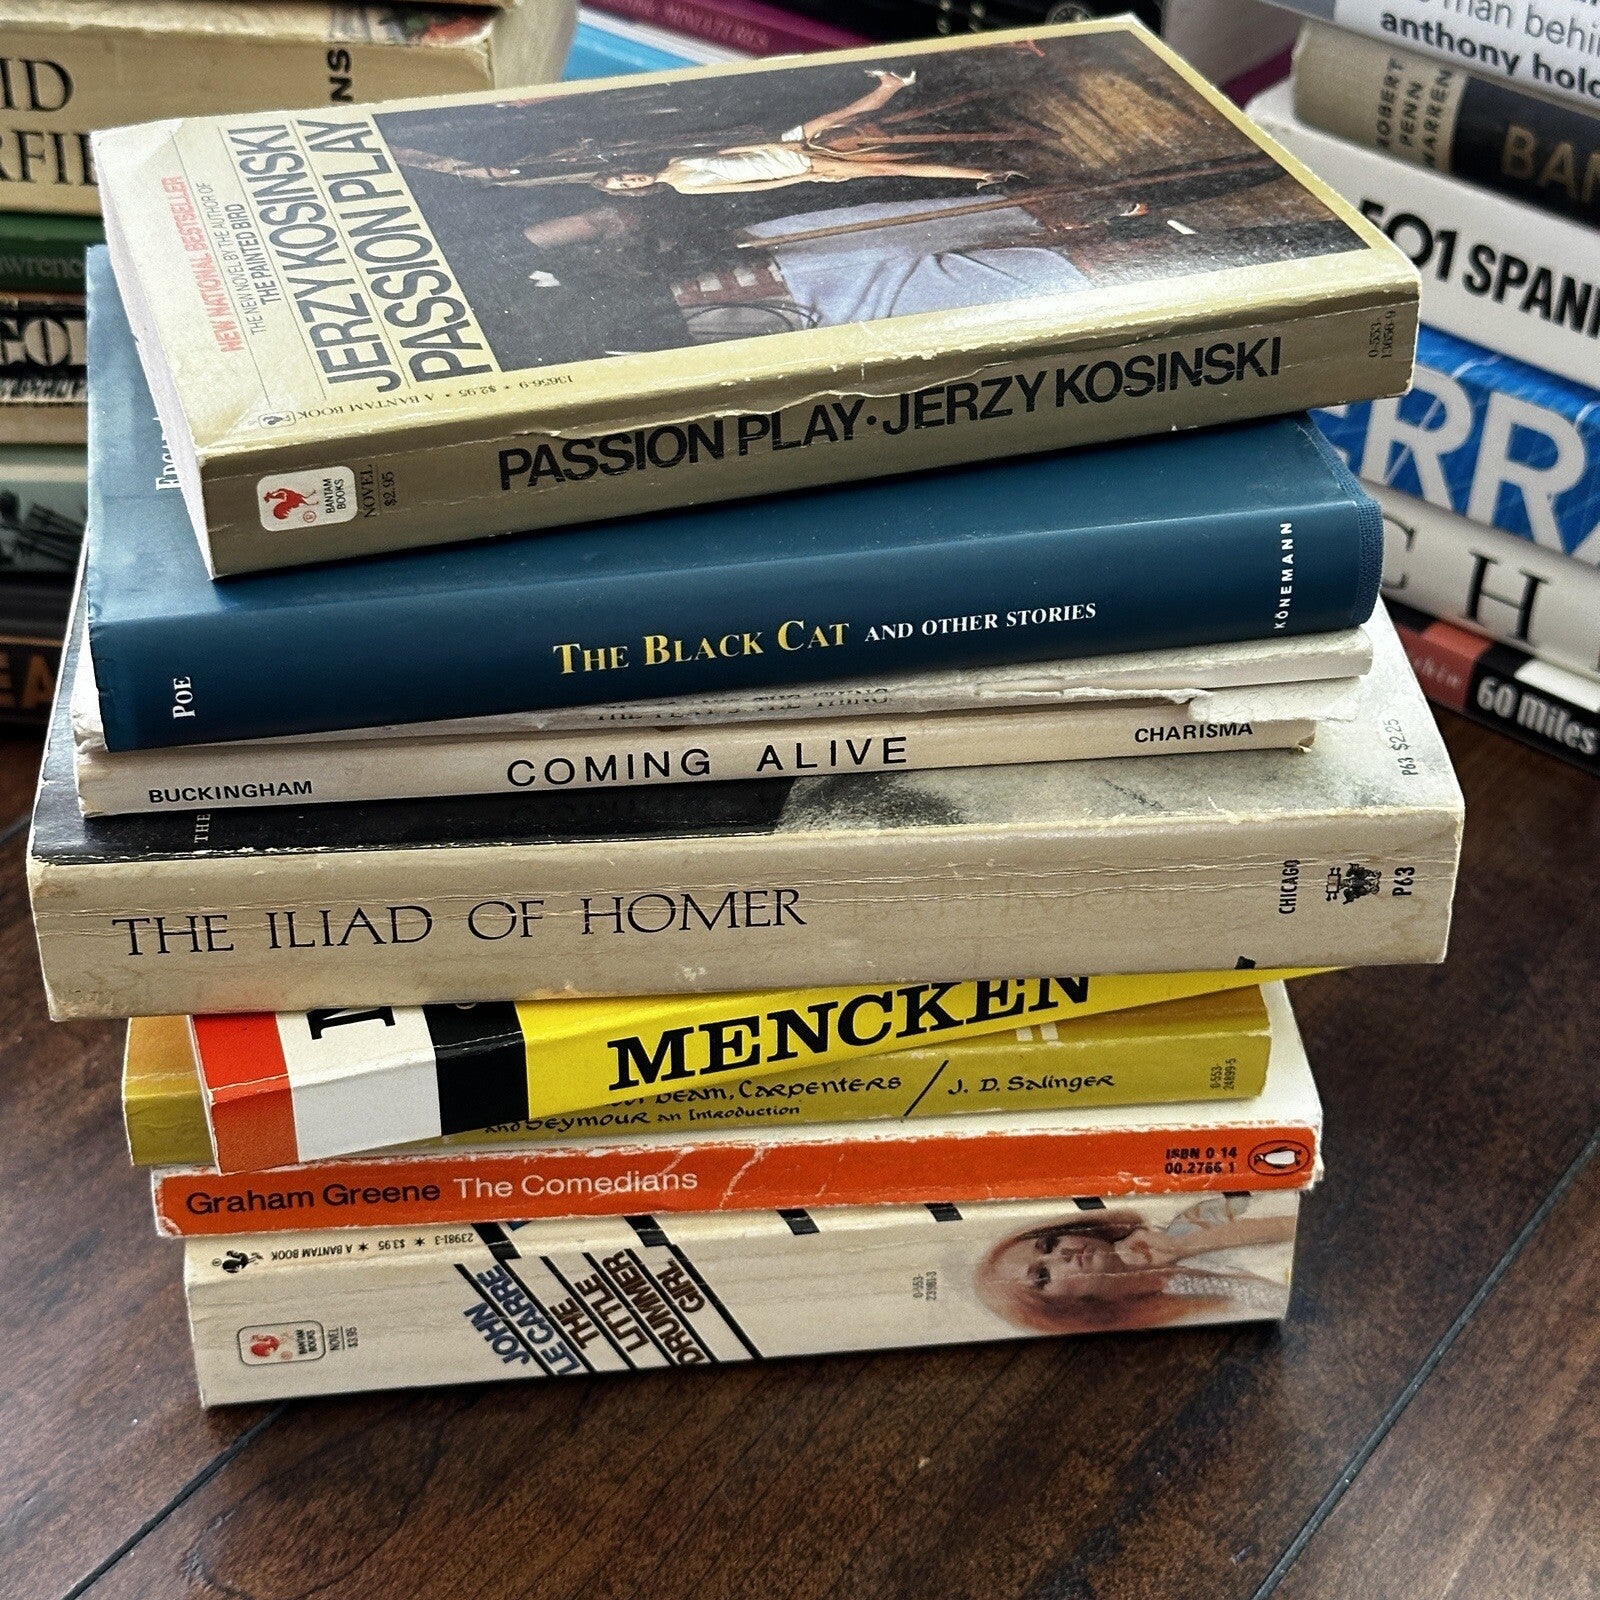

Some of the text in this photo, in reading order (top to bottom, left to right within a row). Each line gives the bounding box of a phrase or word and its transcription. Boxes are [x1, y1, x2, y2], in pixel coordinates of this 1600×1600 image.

[1381, 12, 1520, 76] anthony
[1524, 4, 1600, 57] behi
[1400, 81, 1423, 147] PENN
[161, 176, 245, 352] NEW NATIONAL BESTSELLER
[196, 183, 267, 335] THE NEW NOVEL BY THE AUTHOR OF
[225, 204, 281, 305] THE PAINTED BIRD
[227, 124, 402, 393] JERZY KOSINSKI
[297, 120, 493, 383] PASSION PLAY
[296, 374, 574, 420] 13656-9 $2.95 A BANTAM BOOK
[499, 336, 1282, 491] PASSION PLAY JERZY KOSINSKI
[325, 478, 335, 515] BANTAM
[336, 478, 347, 511] BOOKS
[360, 463, 379, 520] NOVEL
[382, 470, 398, 507] $2.95
[1274, 522, 1295, 629] KÖNEMANN
[552, 601, 1097, 675] THE BLACK CAT AND OTHER STORIES
[172, 676, 196, 720] POE
[1476, 675, 1519, 719] 60
[1134, 722, 1253, 743] CHARISMA
[1383, 718, 1418, 777] P63 $2.25
[507, 736, 908, 788] COMING ALIVE
[149, 780, 313, 803] BUCKINGHAM
[194, 813, 211, 844] THE
[1279, 859, 1300, 915] CHICAGO
[1392, 866, 1415, 897] P63
[112, 888, 807, 956] THE ILIAD OF HOMER
[607, 976, 1090, 1092] MENCKEN
[947, 1078, 969, 1095] J.
[978, 1076, 1000, 1093] D.
[657, 1112, 681, 1122] an
[688, 1106, 800, 1122] Introduction
[1165, 1146, 1238, 1160] ISBN 0 14
[1228, 1161, 1235, 1173] 1
[186, 1169, 699, 1217] Graham Greene The Comedians
[271, 1231, 474, 1261] 23981-3 $3.95 A BANTAM BOOK
[574, 1272, 650, 1353] LITTLE
[602, 1250, 705, 1365] DRUMMER
[656, 1257, 706, 1314] GIRL
[463, 1302, 531, 1365] JOHN
[476, 1264, 582, 1376] LE CARRE
[550, 1297, 600, 1350] THE
